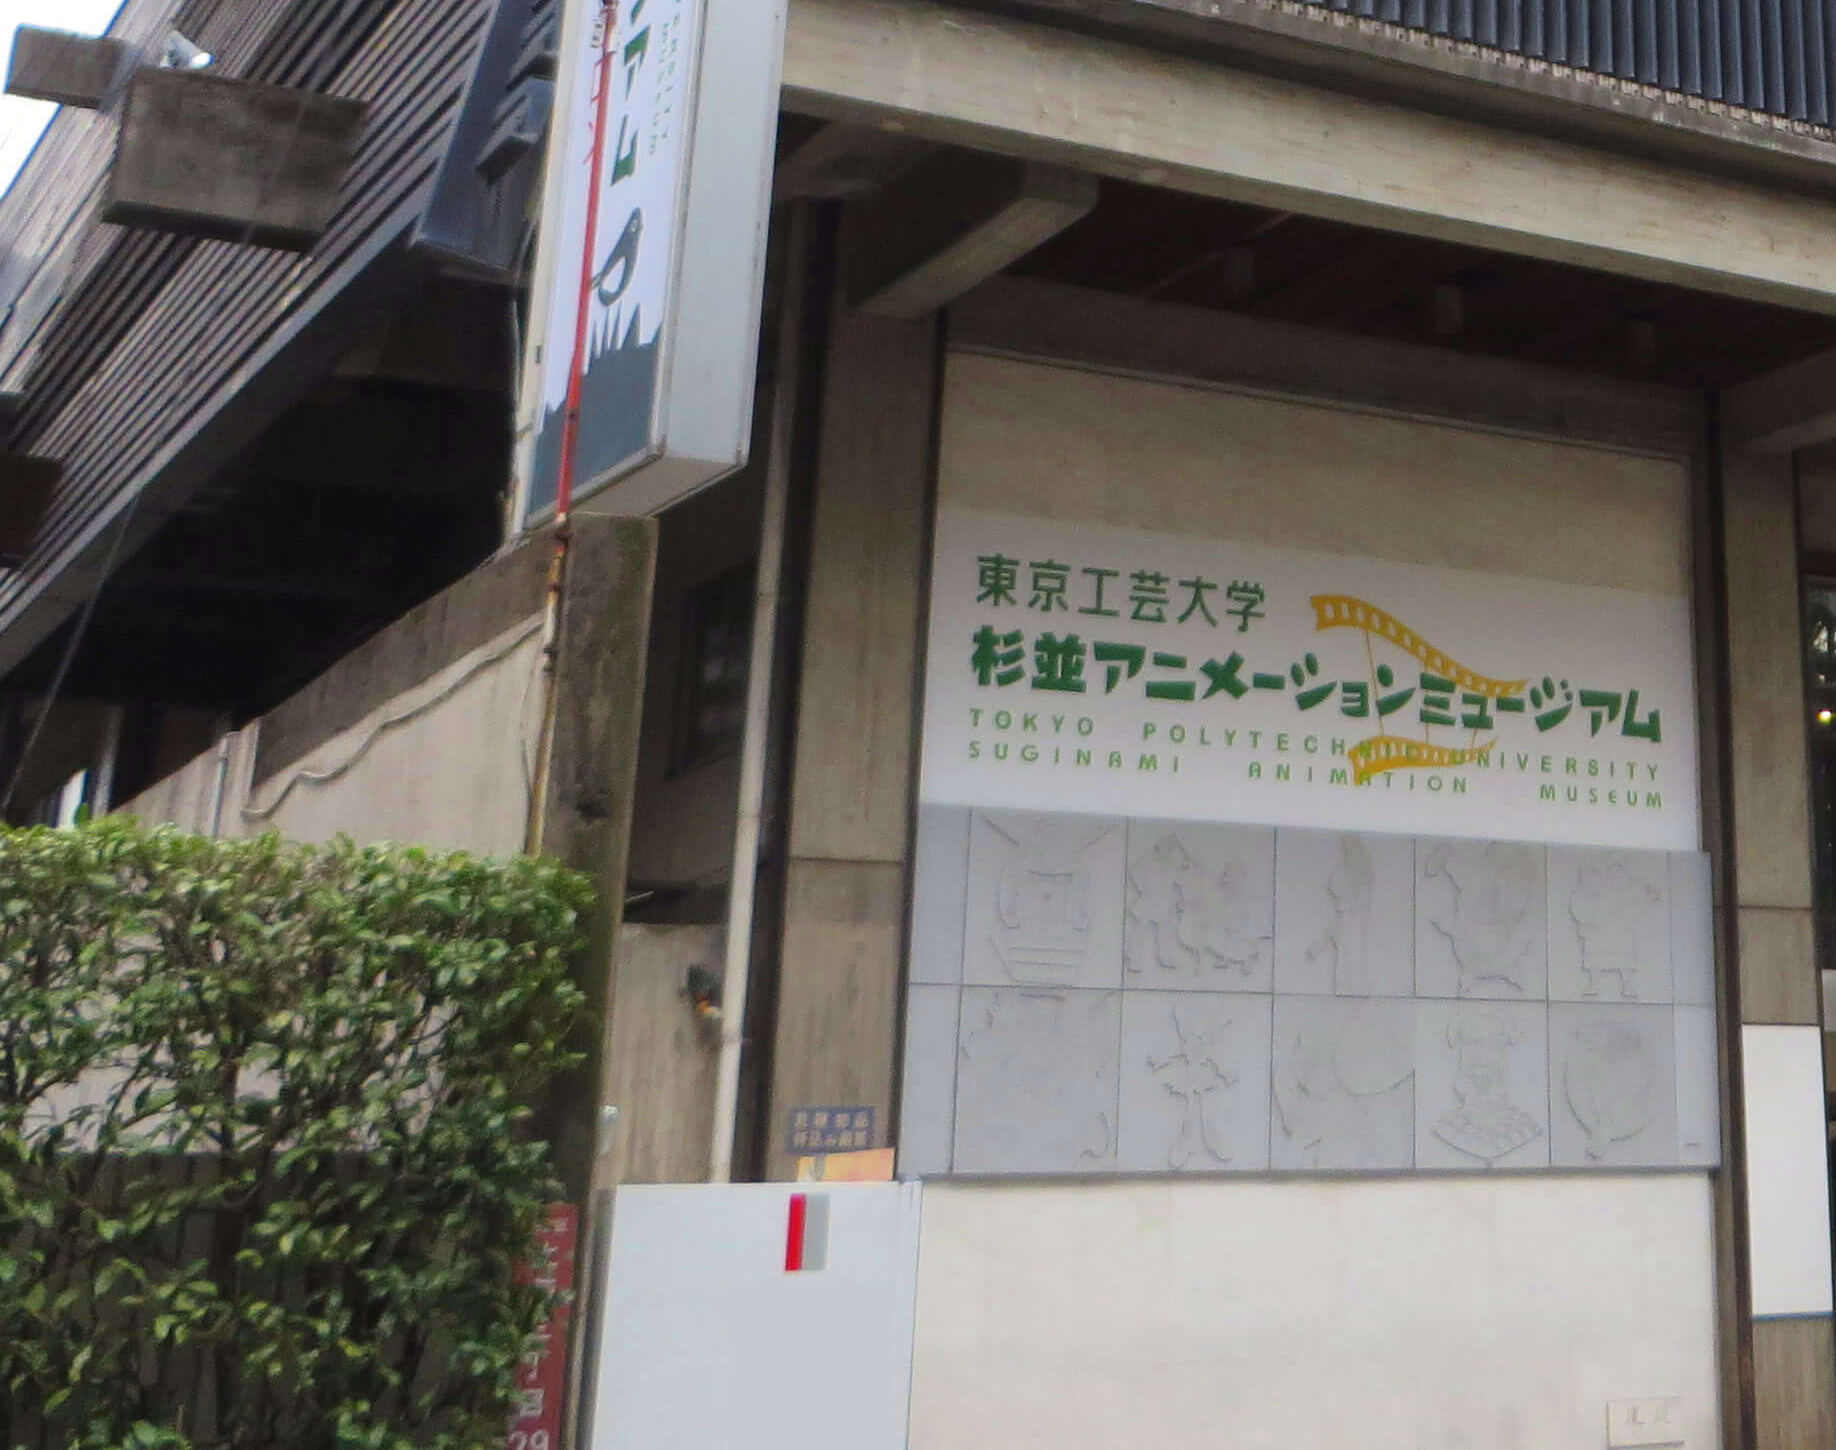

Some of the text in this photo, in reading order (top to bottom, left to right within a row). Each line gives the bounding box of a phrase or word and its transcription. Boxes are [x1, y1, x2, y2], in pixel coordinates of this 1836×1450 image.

[975, 552, 1266, 633] 東京工芸大学
[970, 623, 1663, 744] 杉並アニメーションミュージアム
[968, 706, 1659, 782] TOKYO POLYTECHNIC UNIVERSITY
[968, 740, 1664, 808] SUGINAMI ANIMATION MUSEUM
